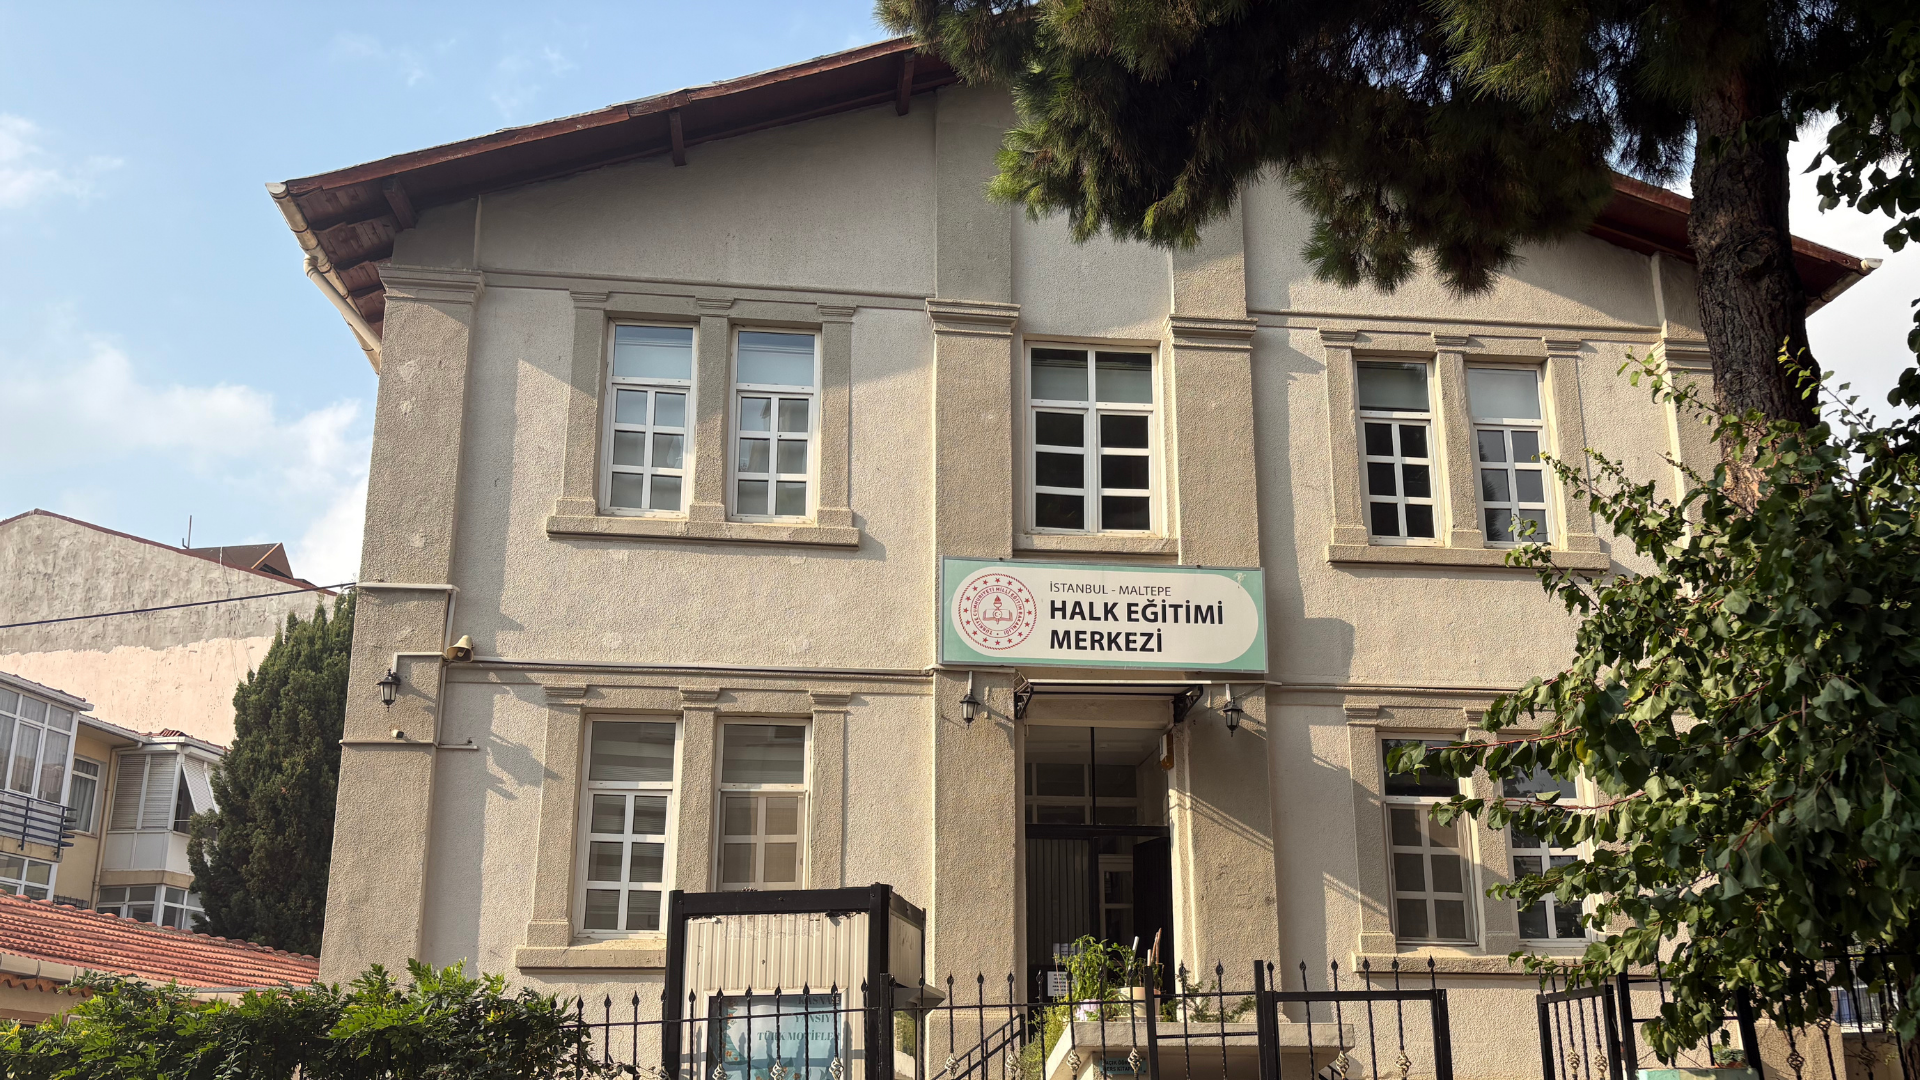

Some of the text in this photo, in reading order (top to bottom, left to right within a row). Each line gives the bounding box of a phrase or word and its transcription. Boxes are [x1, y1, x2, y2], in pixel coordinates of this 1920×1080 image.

[1050, 581, 1108, 595] İSTANBUL
[1118, 585, 1171, 597] MALTEPE
[1050, 598, 1223, 625] HALK EĞİTİMİ
[1050, 628, 1162, 653] MERKEZİ
